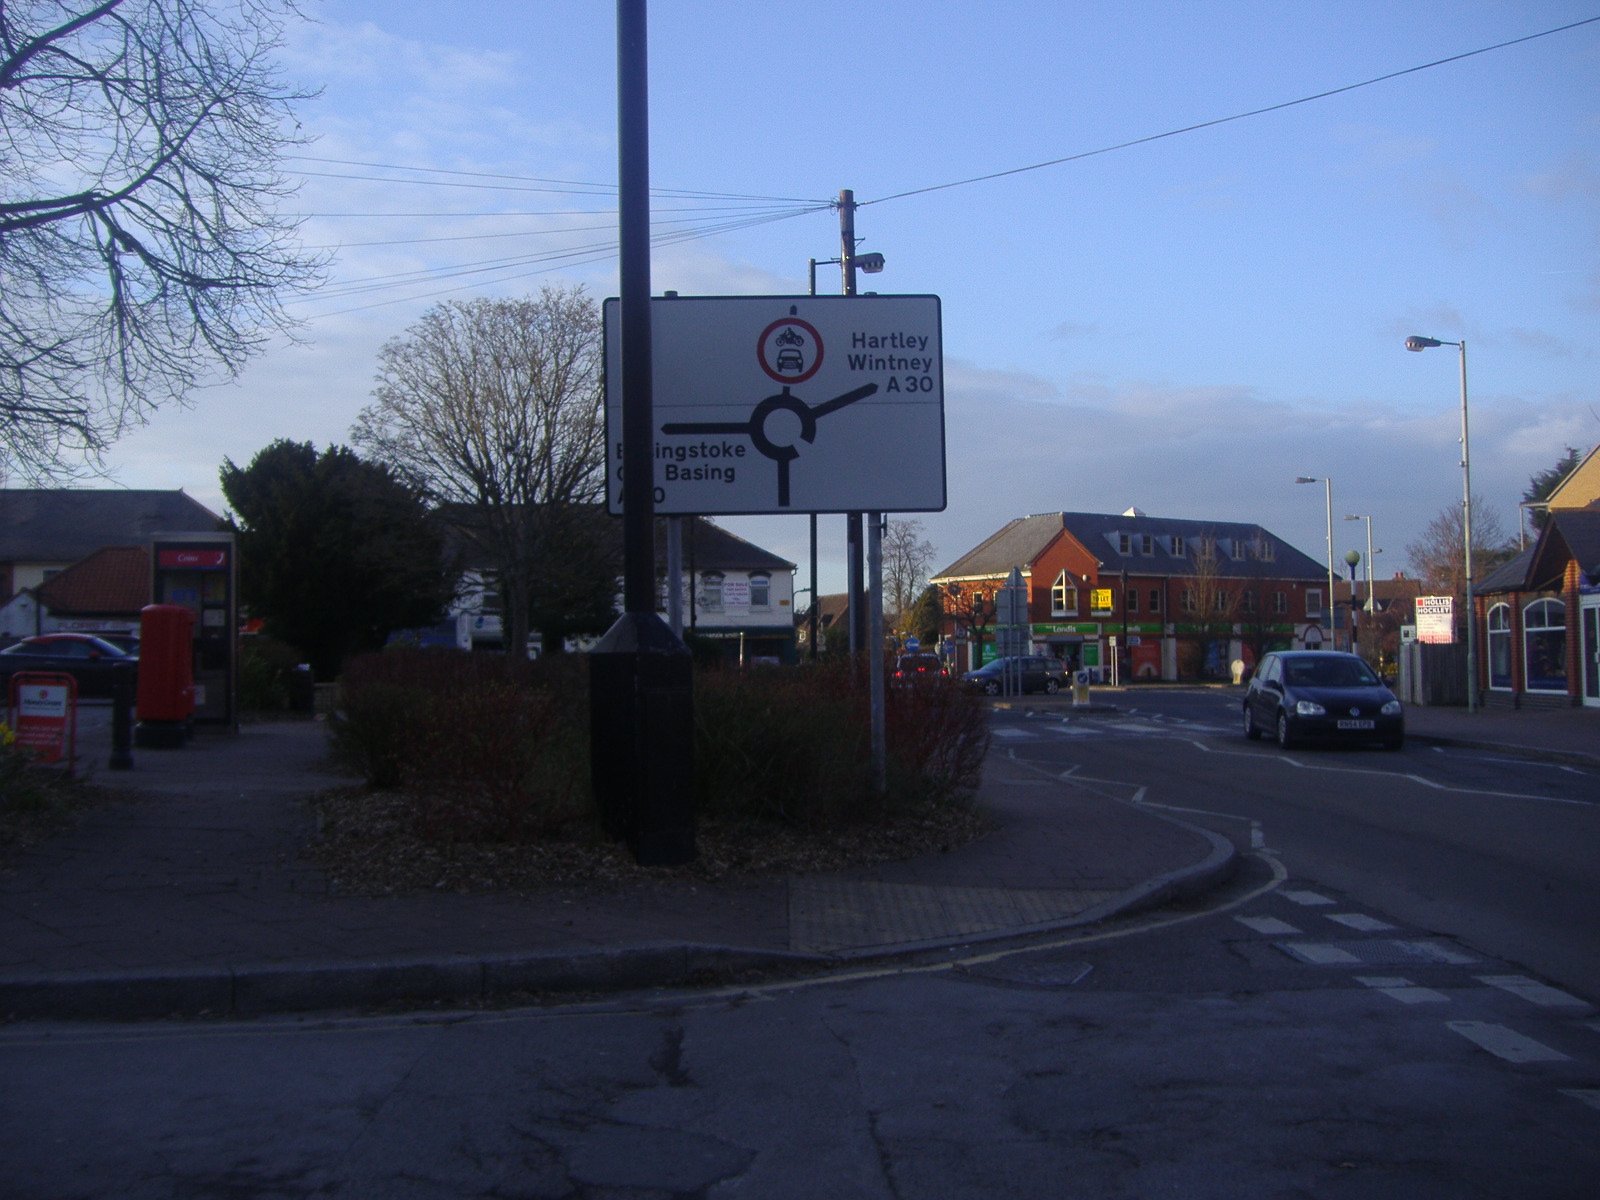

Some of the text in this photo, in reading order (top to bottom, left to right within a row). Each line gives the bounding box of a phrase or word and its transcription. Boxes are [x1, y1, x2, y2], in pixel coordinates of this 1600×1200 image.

[852, 332, 928, 351] Hartley
[847, 354, 932, 373] Wintney
[617, 442, 746, 461] ingstoke
[665, 464, 735, 483] Basing
[177, 553, 199, 562] Coins
[1425, 598, 1450, 606] HOLLIS
[1417, 606, 1450, 615] HOCKLEY
[1053, 625, 1077, 633] Londis
